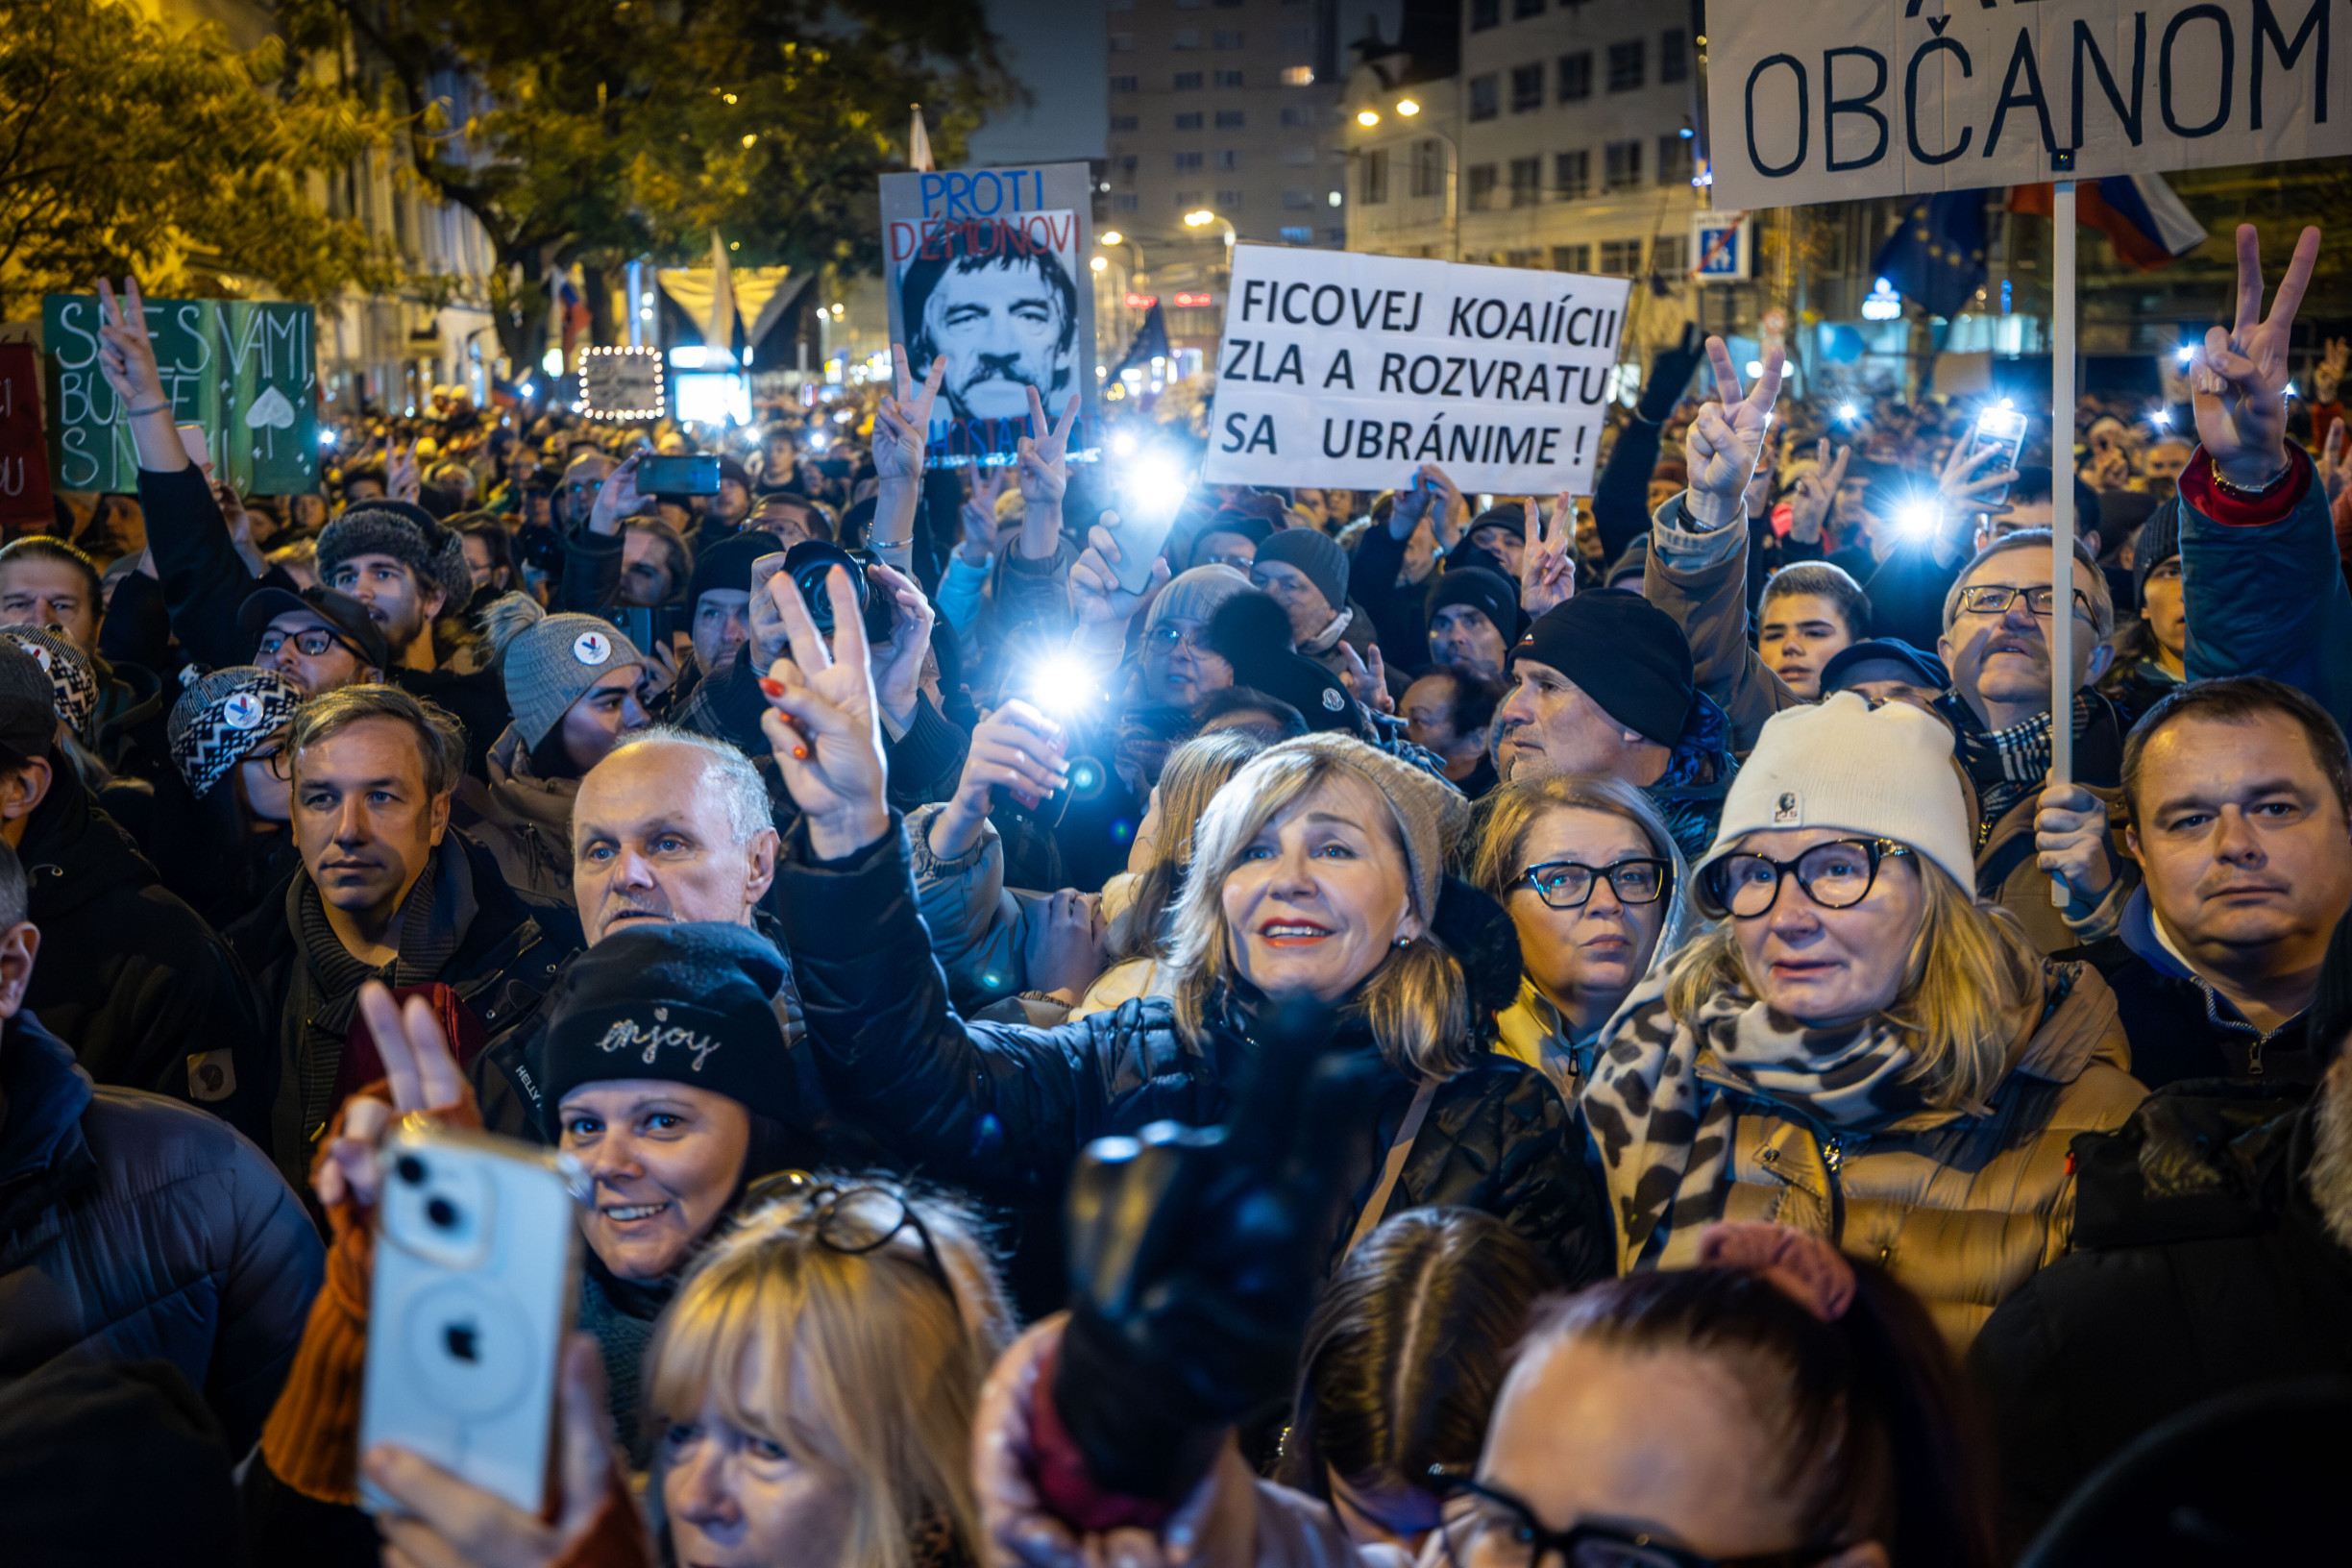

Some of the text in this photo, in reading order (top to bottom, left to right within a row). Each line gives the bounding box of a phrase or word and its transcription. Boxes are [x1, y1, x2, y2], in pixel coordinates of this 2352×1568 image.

[1745, 0, 2331, 177] OBČANOM
[920, 170, 1042, 218] PROTI
[890, 210, 1081, 261] DÉMONOVI
[1241, 280, 1423, 331] FICOVEJ
[1223, 339, 1608, 404] ZLA A ROZVRATU
[1221, 412, 1277, 454] SA
[1323, 411, 1561, 466] UBRÁNIME
[595, 1007, 721, 1072] enjoy
[515, 1065, 542, 1101] HELLY
